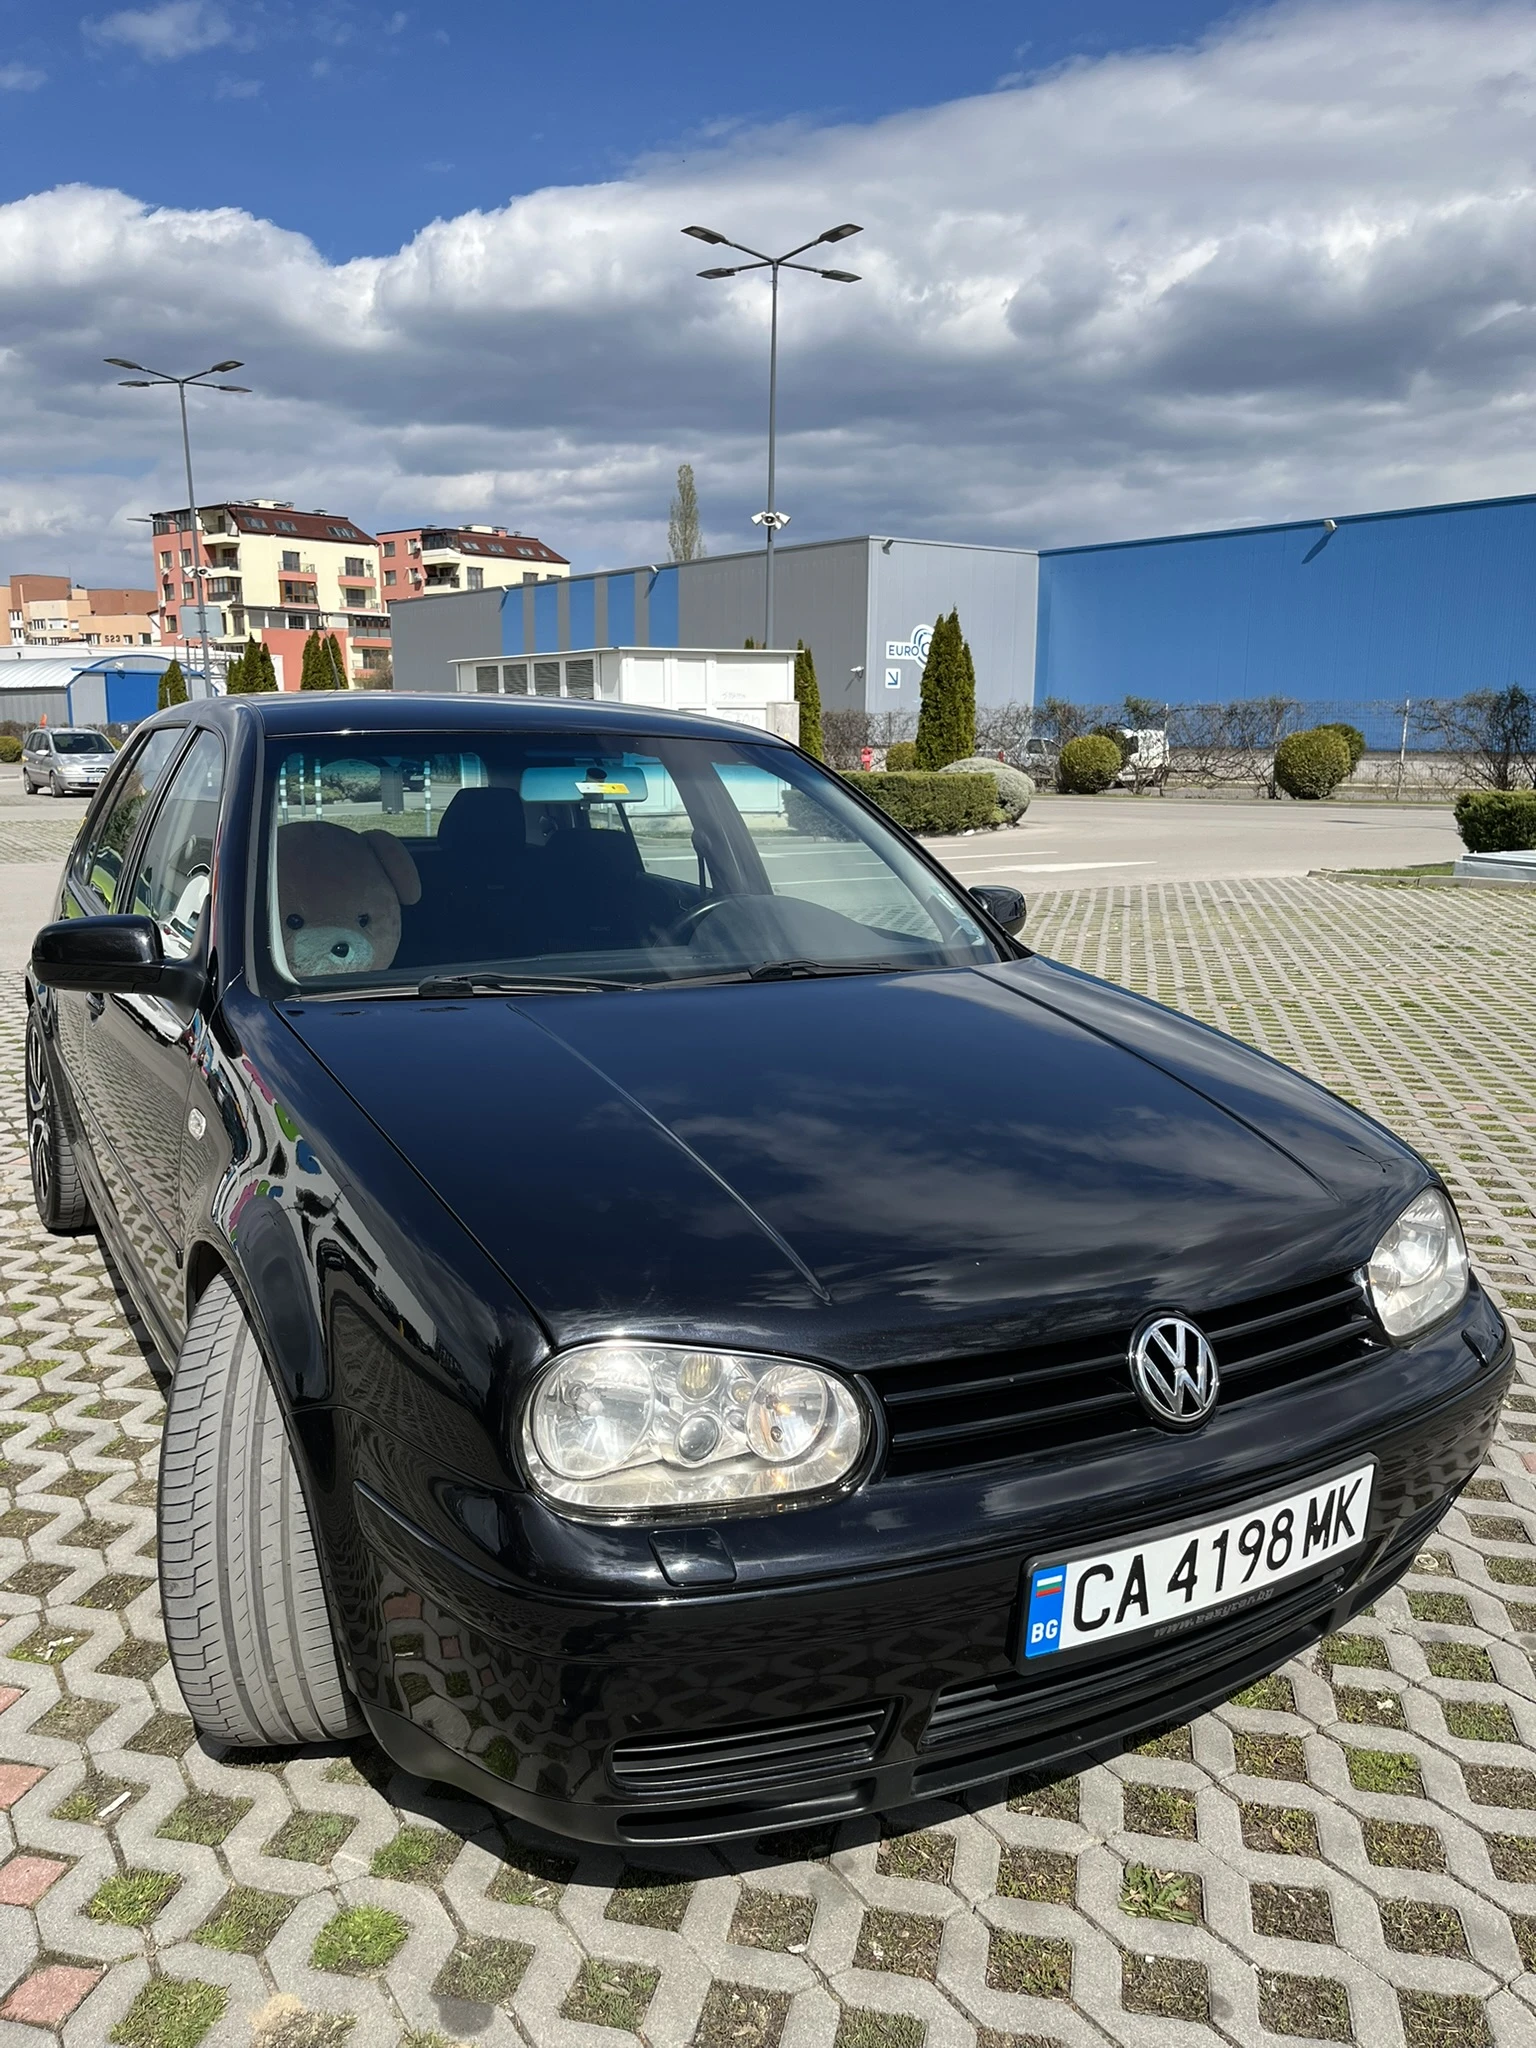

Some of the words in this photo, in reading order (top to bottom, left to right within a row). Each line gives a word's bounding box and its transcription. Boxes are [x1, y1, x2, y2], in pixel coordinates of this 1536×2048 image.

[104, 634, 121, 643] 523
[1138, 1319, 1216, 1420] VW
[1073, 1553, 1150, 1632] CA
[1167, 1507, 1295, 1604] 4198
[1301, 1477, 1364, 1560] MK
[1031, 1618, 1059, 1644] BG
